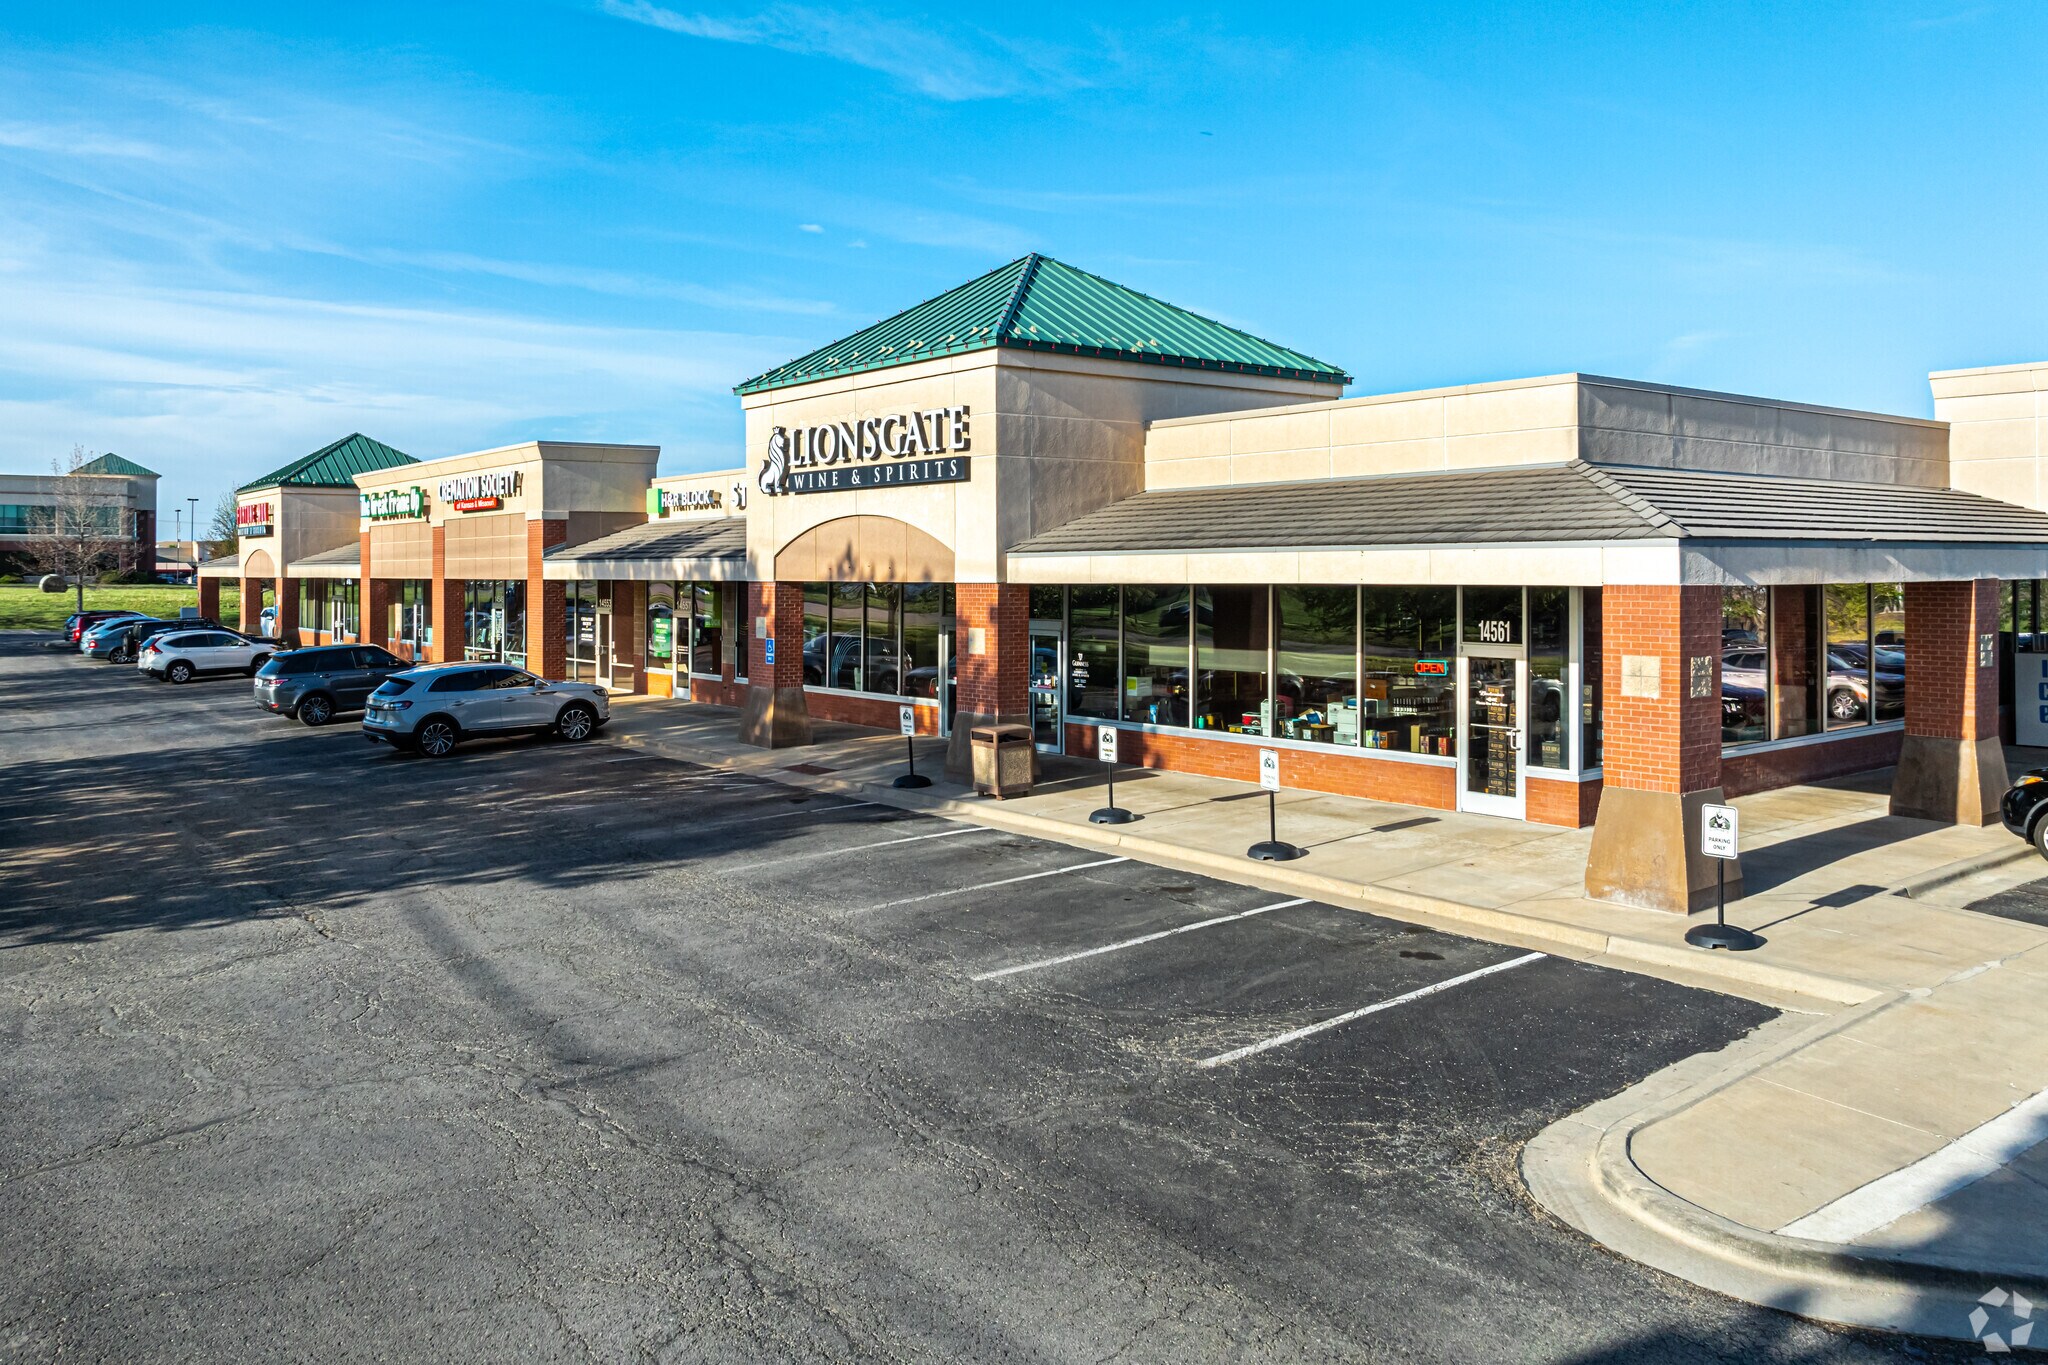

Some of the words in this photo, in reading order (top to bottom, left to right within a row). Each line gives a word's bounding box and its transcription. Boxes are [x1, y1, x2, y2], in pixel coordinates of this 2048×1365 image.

[787, 405, 969, 467] LIONSGATE
[438, 476, 480, 502] CREMATION
[481, 471, 516, 498] SOCIETY
[794, 471, 839, 490] WINE
[851, 469, 862, 485] &
[874, 459, 958, 483] SPIRITS
[370, 492, 388, 516] Great
[388, 489, 409, 515] Frame
[410, 486, 421, 517] Up
[661, 491, 679, 507] H&R
[681, 489, 711, 506] BLOCK
[1478, 620, 1510, 643] 14561
[1414, 662, 1445, 673] OPEN
[1708, 836, 1731, 844] PARKING
